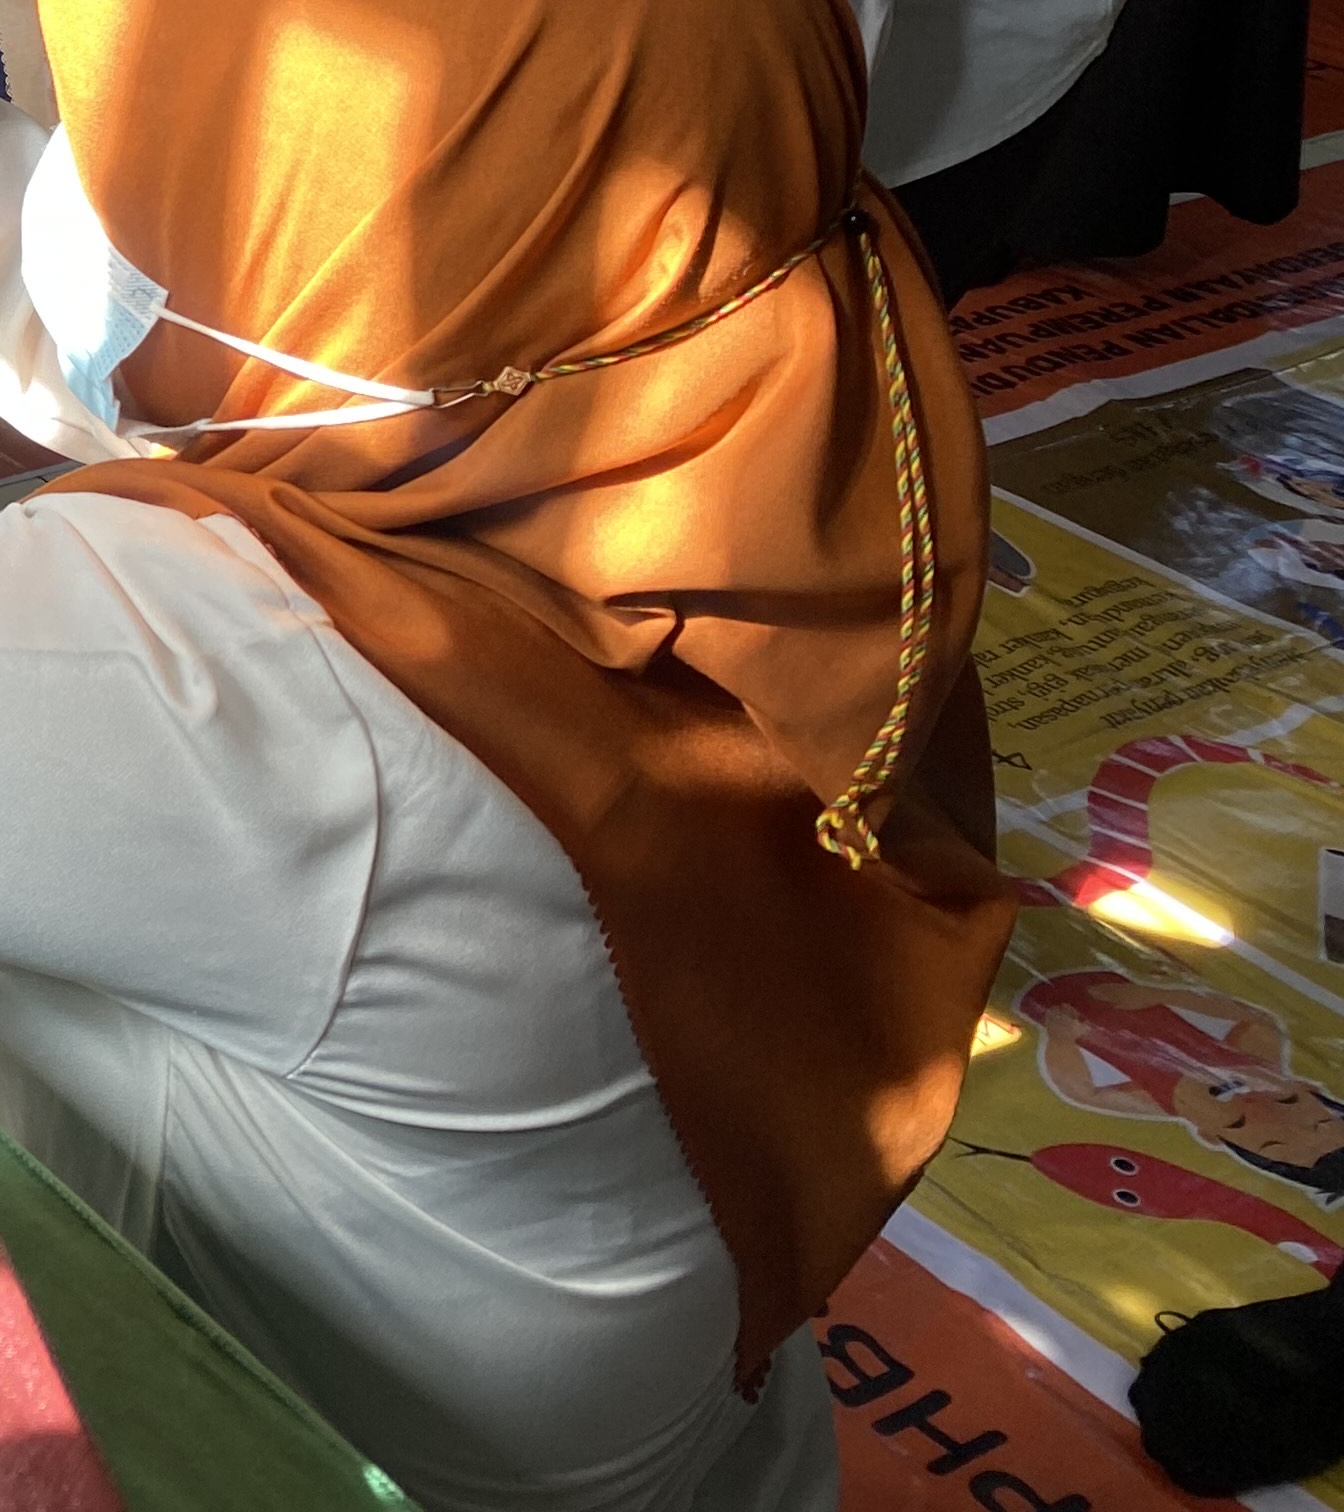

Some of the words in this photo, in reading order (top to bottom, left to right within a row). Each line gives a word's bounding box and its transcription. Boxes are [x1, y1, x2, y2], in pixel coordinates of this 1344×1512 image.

[951, 284, 1096, 335] KABUPA
[960, 294, 1171, 365] PEREMPUAN
[984, 654, 1062, 688] kanker
